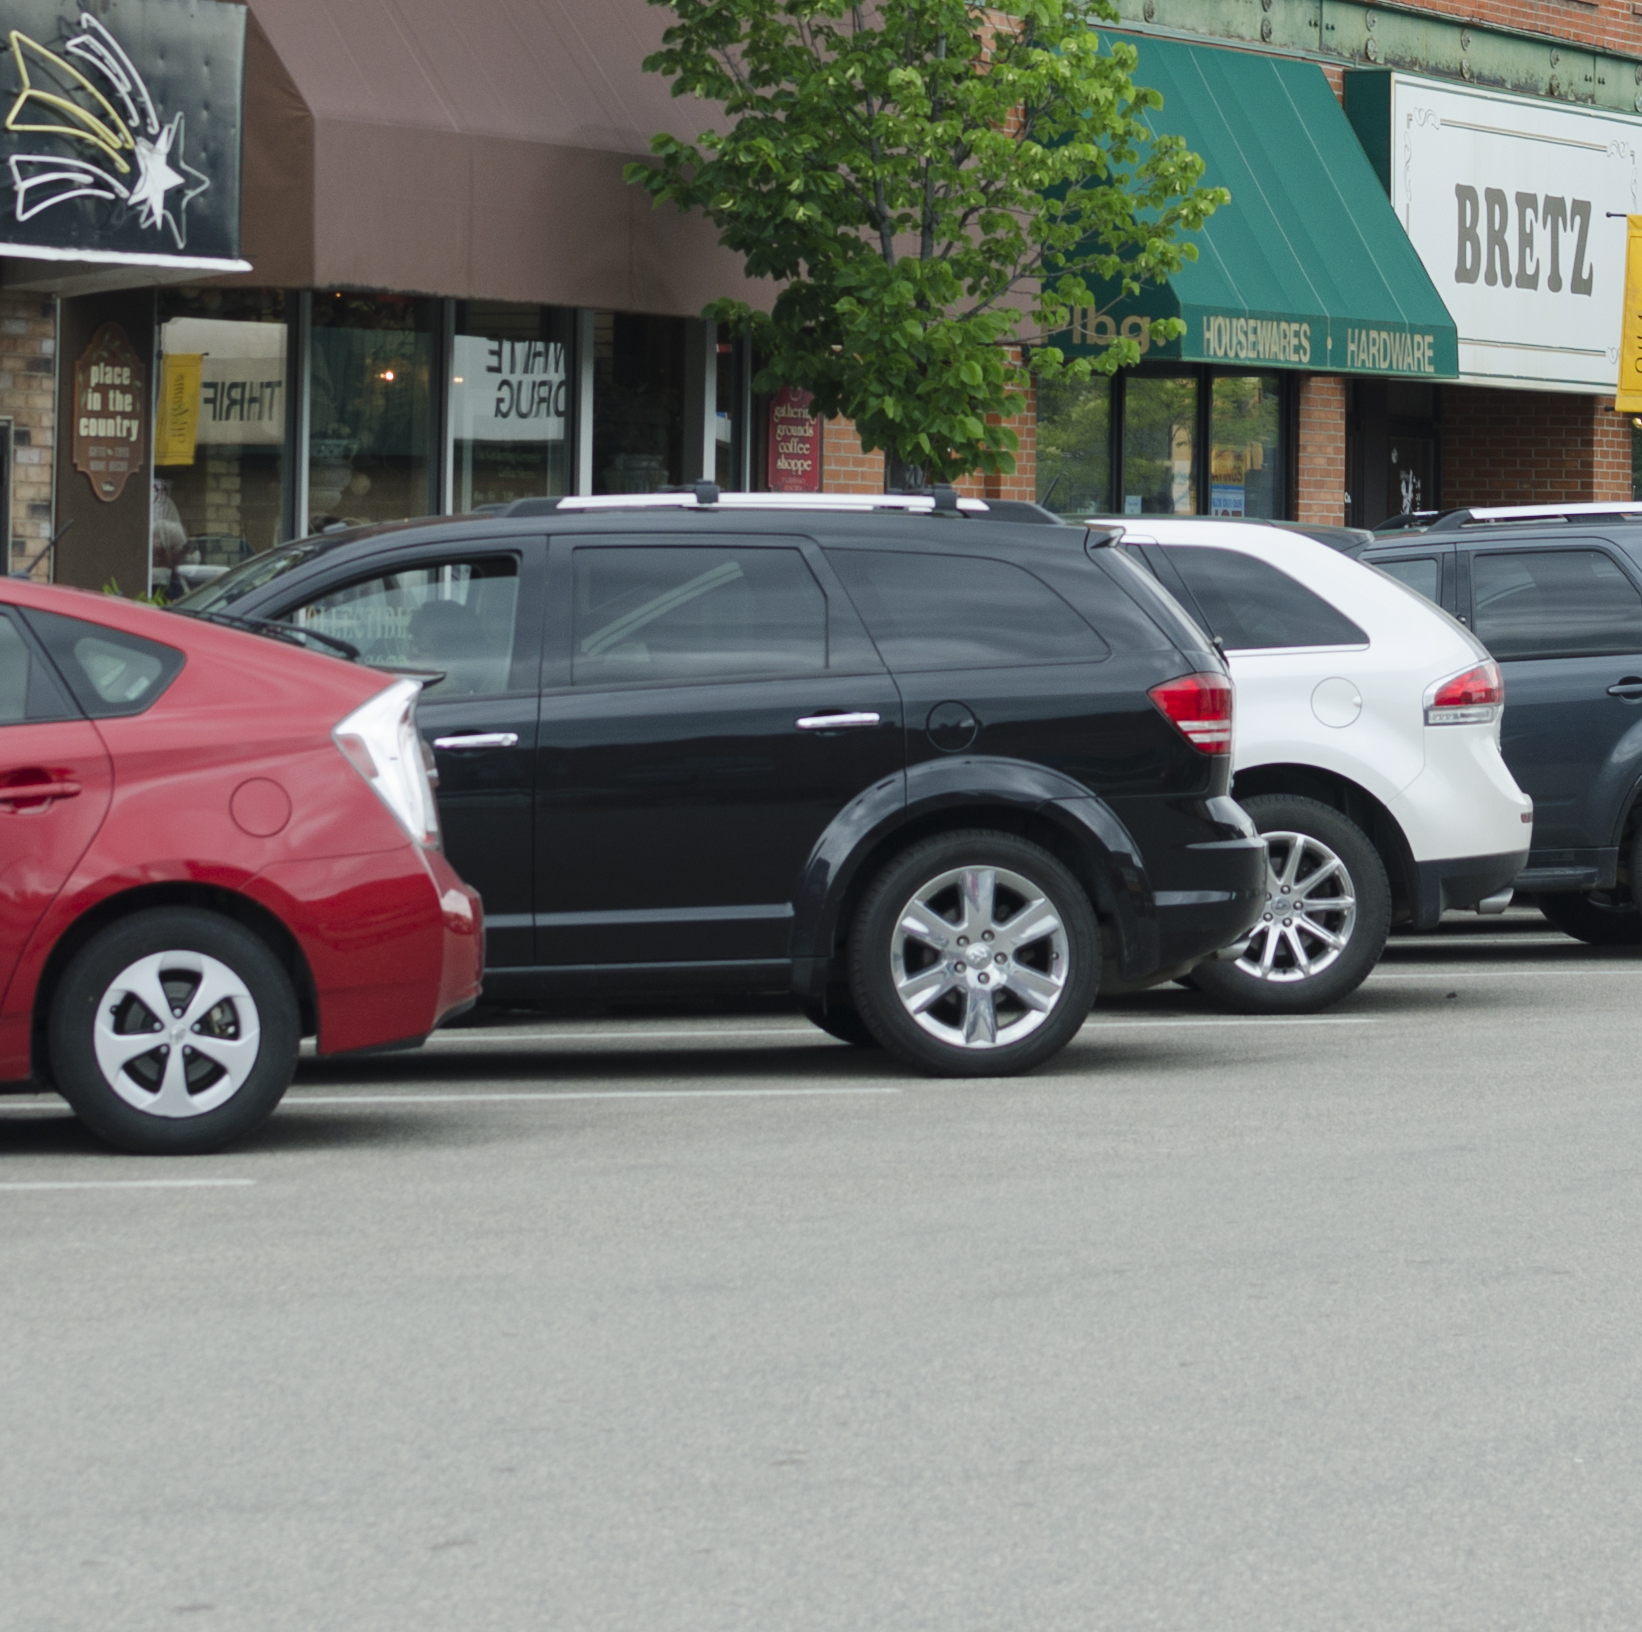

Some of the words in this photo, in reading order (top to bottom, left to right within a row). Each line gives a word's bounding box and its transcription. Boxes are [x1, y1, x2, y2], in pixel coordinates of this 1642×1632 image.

[1454, 183, 1594, 297] BRETZ
[1202, 315, 1311, 363] HOUSEWARES
[1346, 328, 1435, 372] HARDWARE
[90, 362, 131, 388] place
[87, 389, 102, 412] in
[108, 389, 133, 413] the
[79, 415, 140, 442] country
[775, 421, 814, 441] grounds
[778, 437, 811, 455] coffee
[776, 454, 812, 475] shoppe
